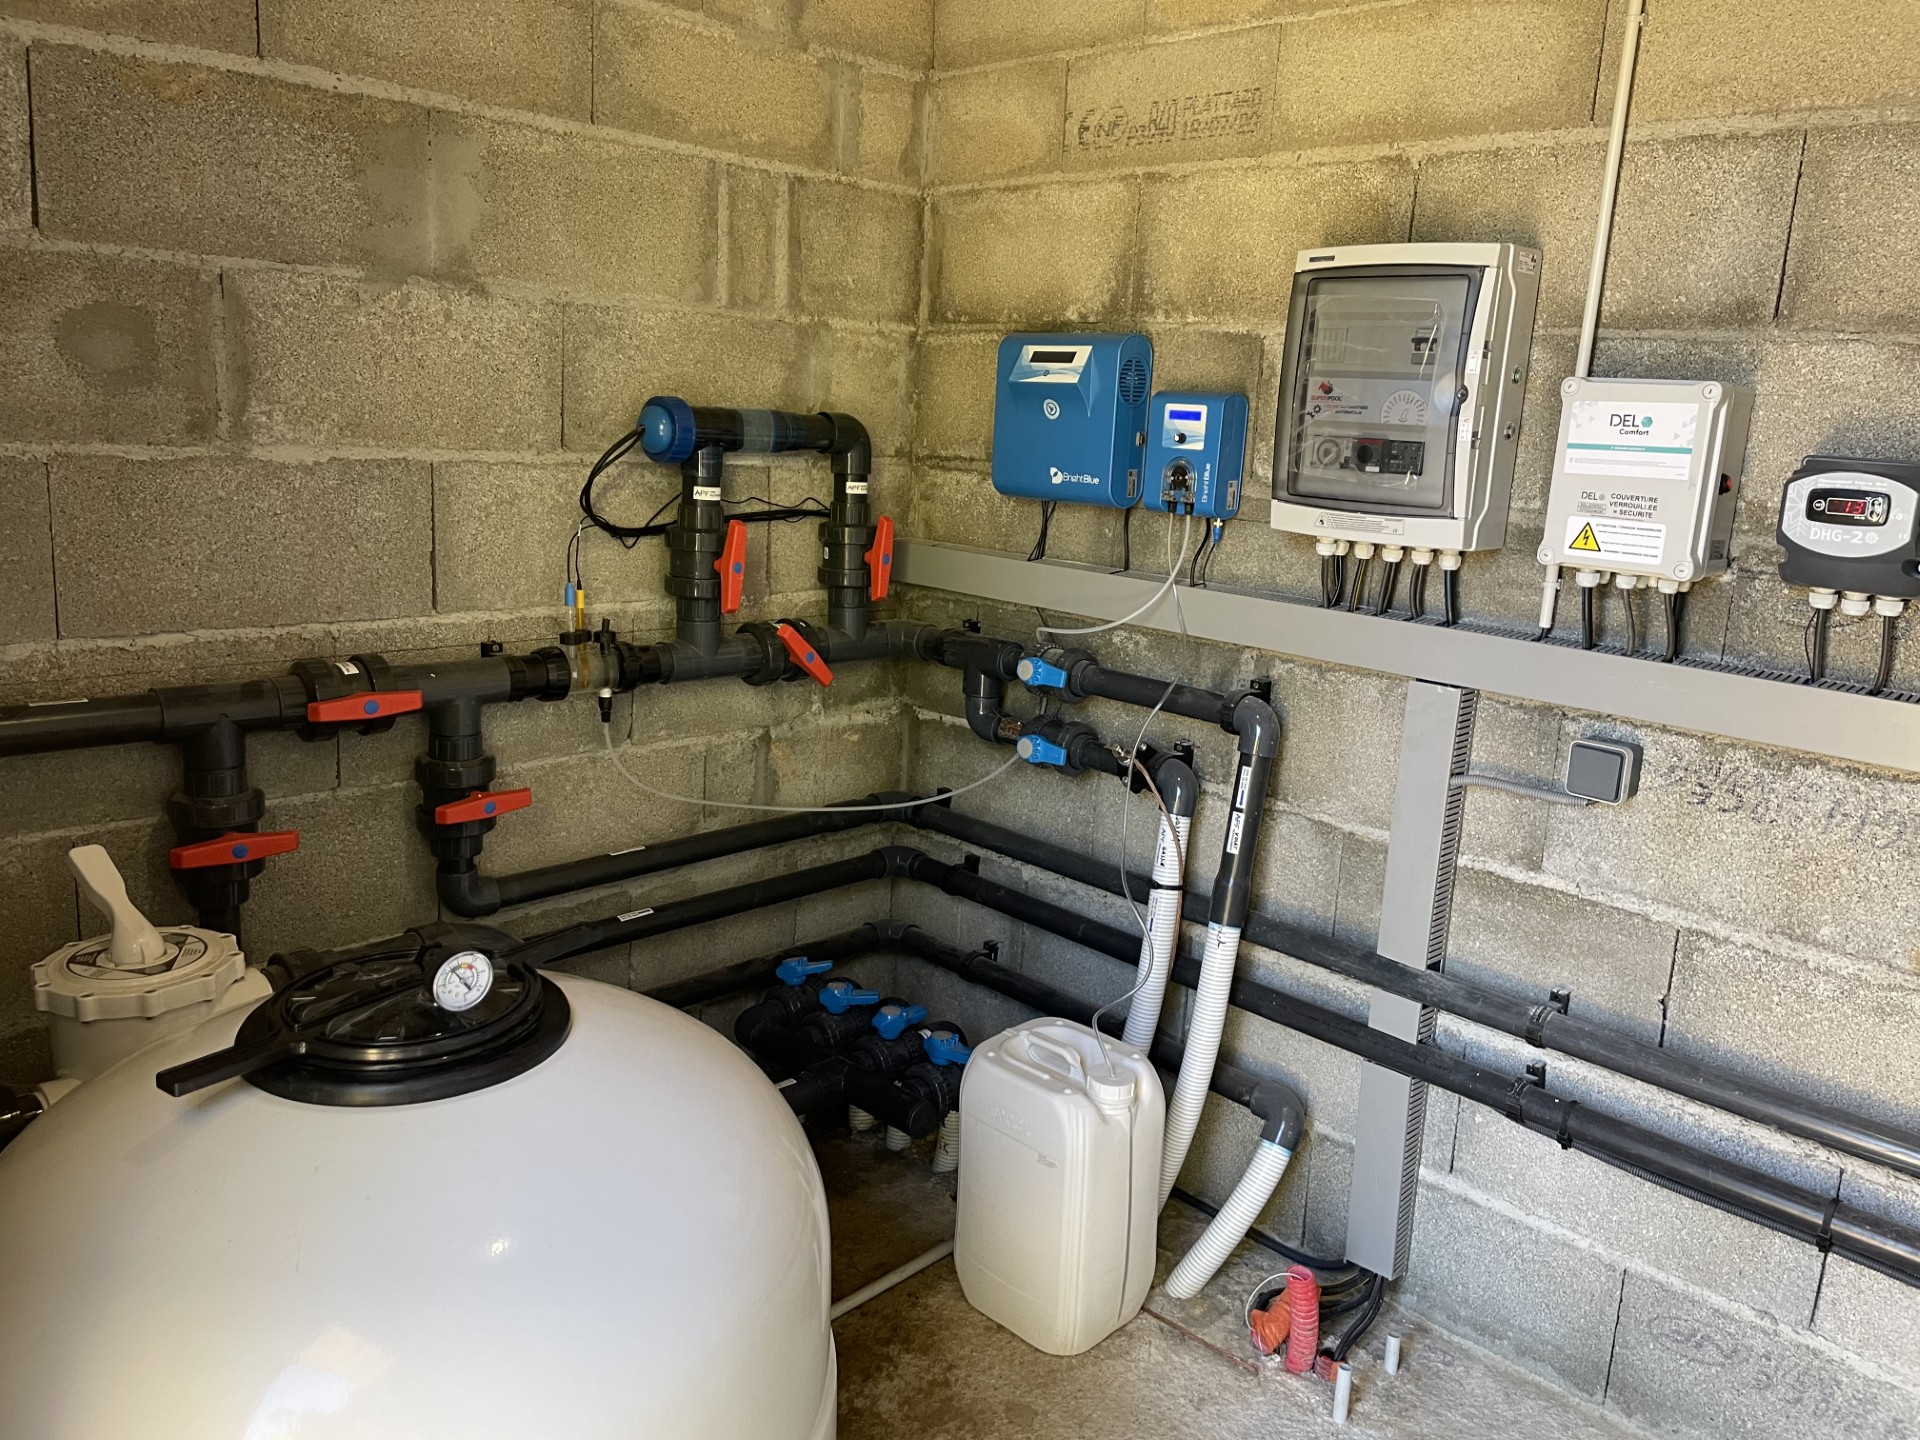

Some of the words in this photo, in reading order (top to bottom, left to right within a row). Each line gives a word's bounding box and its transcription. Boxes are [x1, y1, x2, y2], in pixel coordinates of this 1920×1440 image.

[1609, 413, 1639, 428] DEL
[1619, 428, 1649, 436] Comfort
[1581, 491, 1598, 501] DEL
[1611, 493, 1659, 504] COUVERTURE
[1844, 500, 1864, 515] 13
